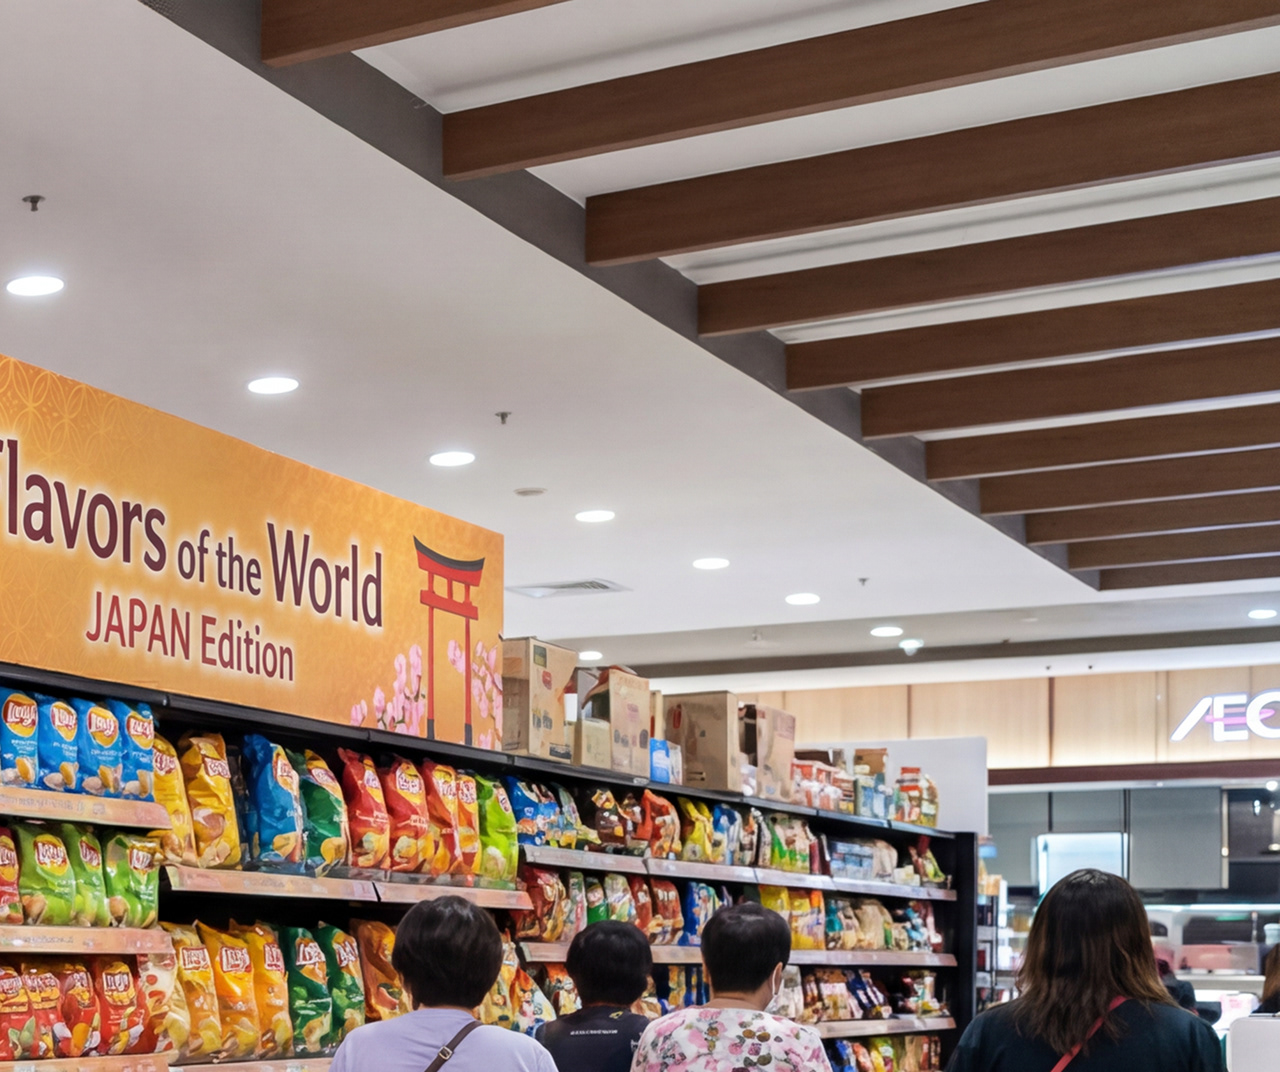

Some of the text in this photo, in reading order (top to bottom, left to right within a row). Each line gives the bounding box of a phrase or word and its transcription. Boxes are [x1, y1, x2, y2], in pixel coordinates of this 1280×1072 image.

[178, 529, 210, 581] of
[216, 536, 261, 595] the
[267, 522, 382, 627] World
[86, 592, 294, 681] JAPAN Edition
